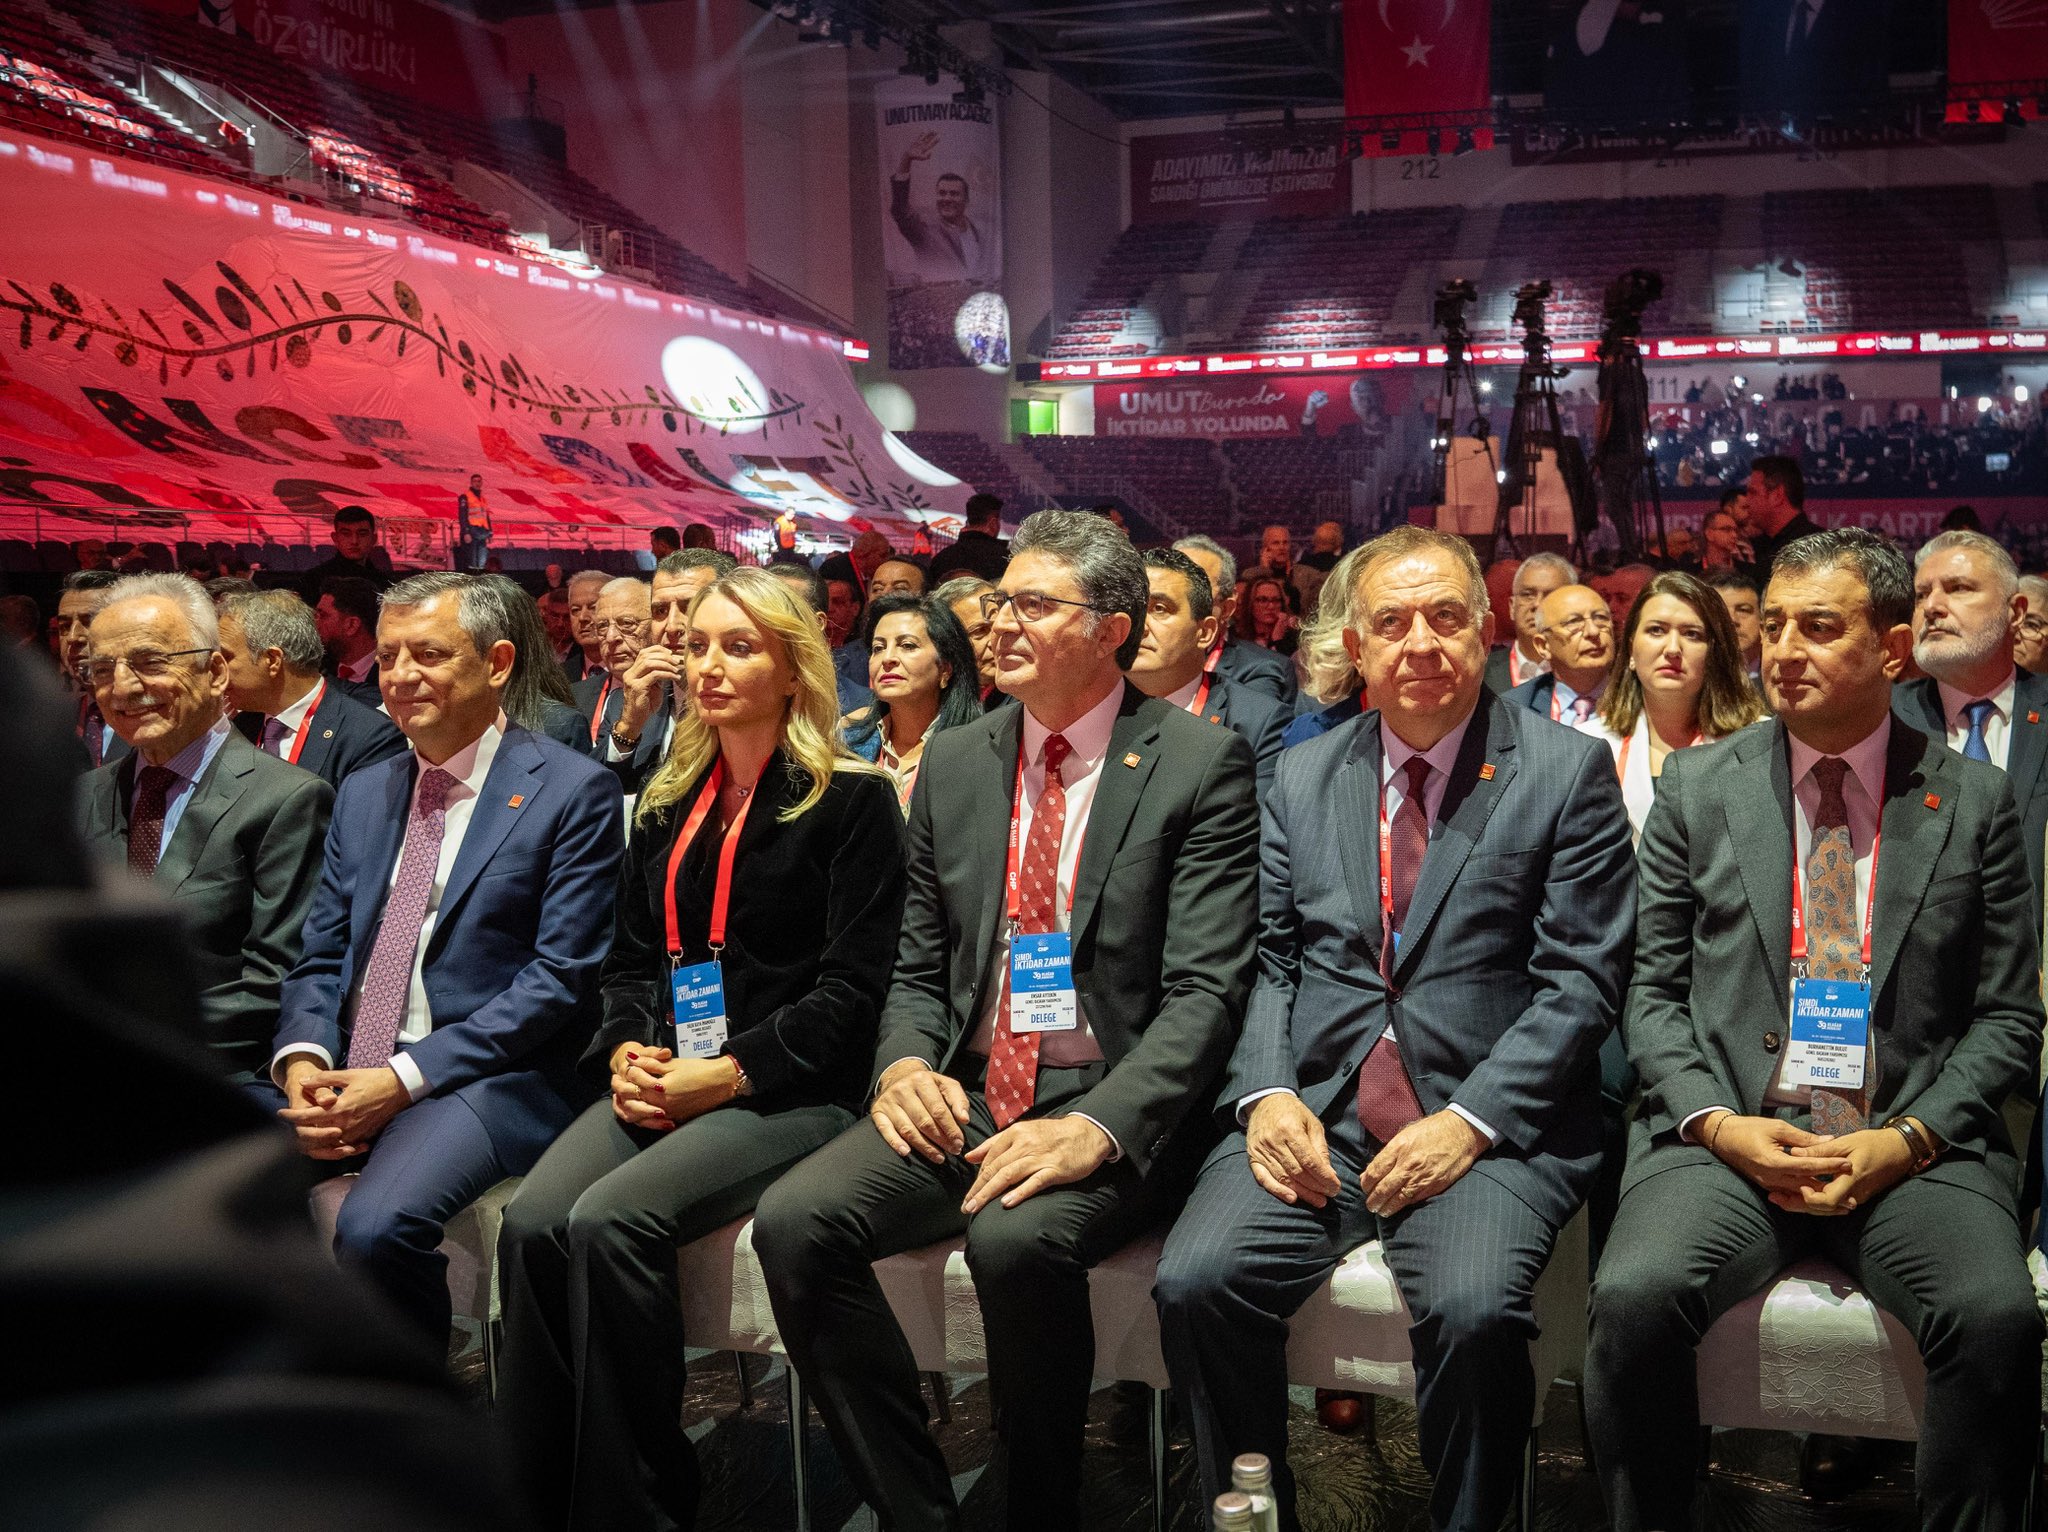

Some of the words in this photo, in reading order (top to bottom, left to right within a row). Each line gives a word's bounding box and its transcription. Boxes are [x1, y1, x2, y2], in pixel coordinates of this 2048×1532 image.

[1401, 159, 1440, 181] 212
[1119, 390, 1201, 415] UMUT
[1107, 416, 1187, 436] İKTİDAR
[1190, 415, 1290, 433] YOLUNDA
[1009, 871, 1017, 891] CHP
[1014, 958, 1043, 971] İKTİDAR
[1031, 1012, 1057, 1024] DELEGE
[1797, 1005, 1831, 1017] İKTİDAR
[1831, 1007, 1864, 1019] ZAMANI
[694, 1039, 713, 1051] DELEGE
[1810, 1065, 1840, 1079] DELEGE
